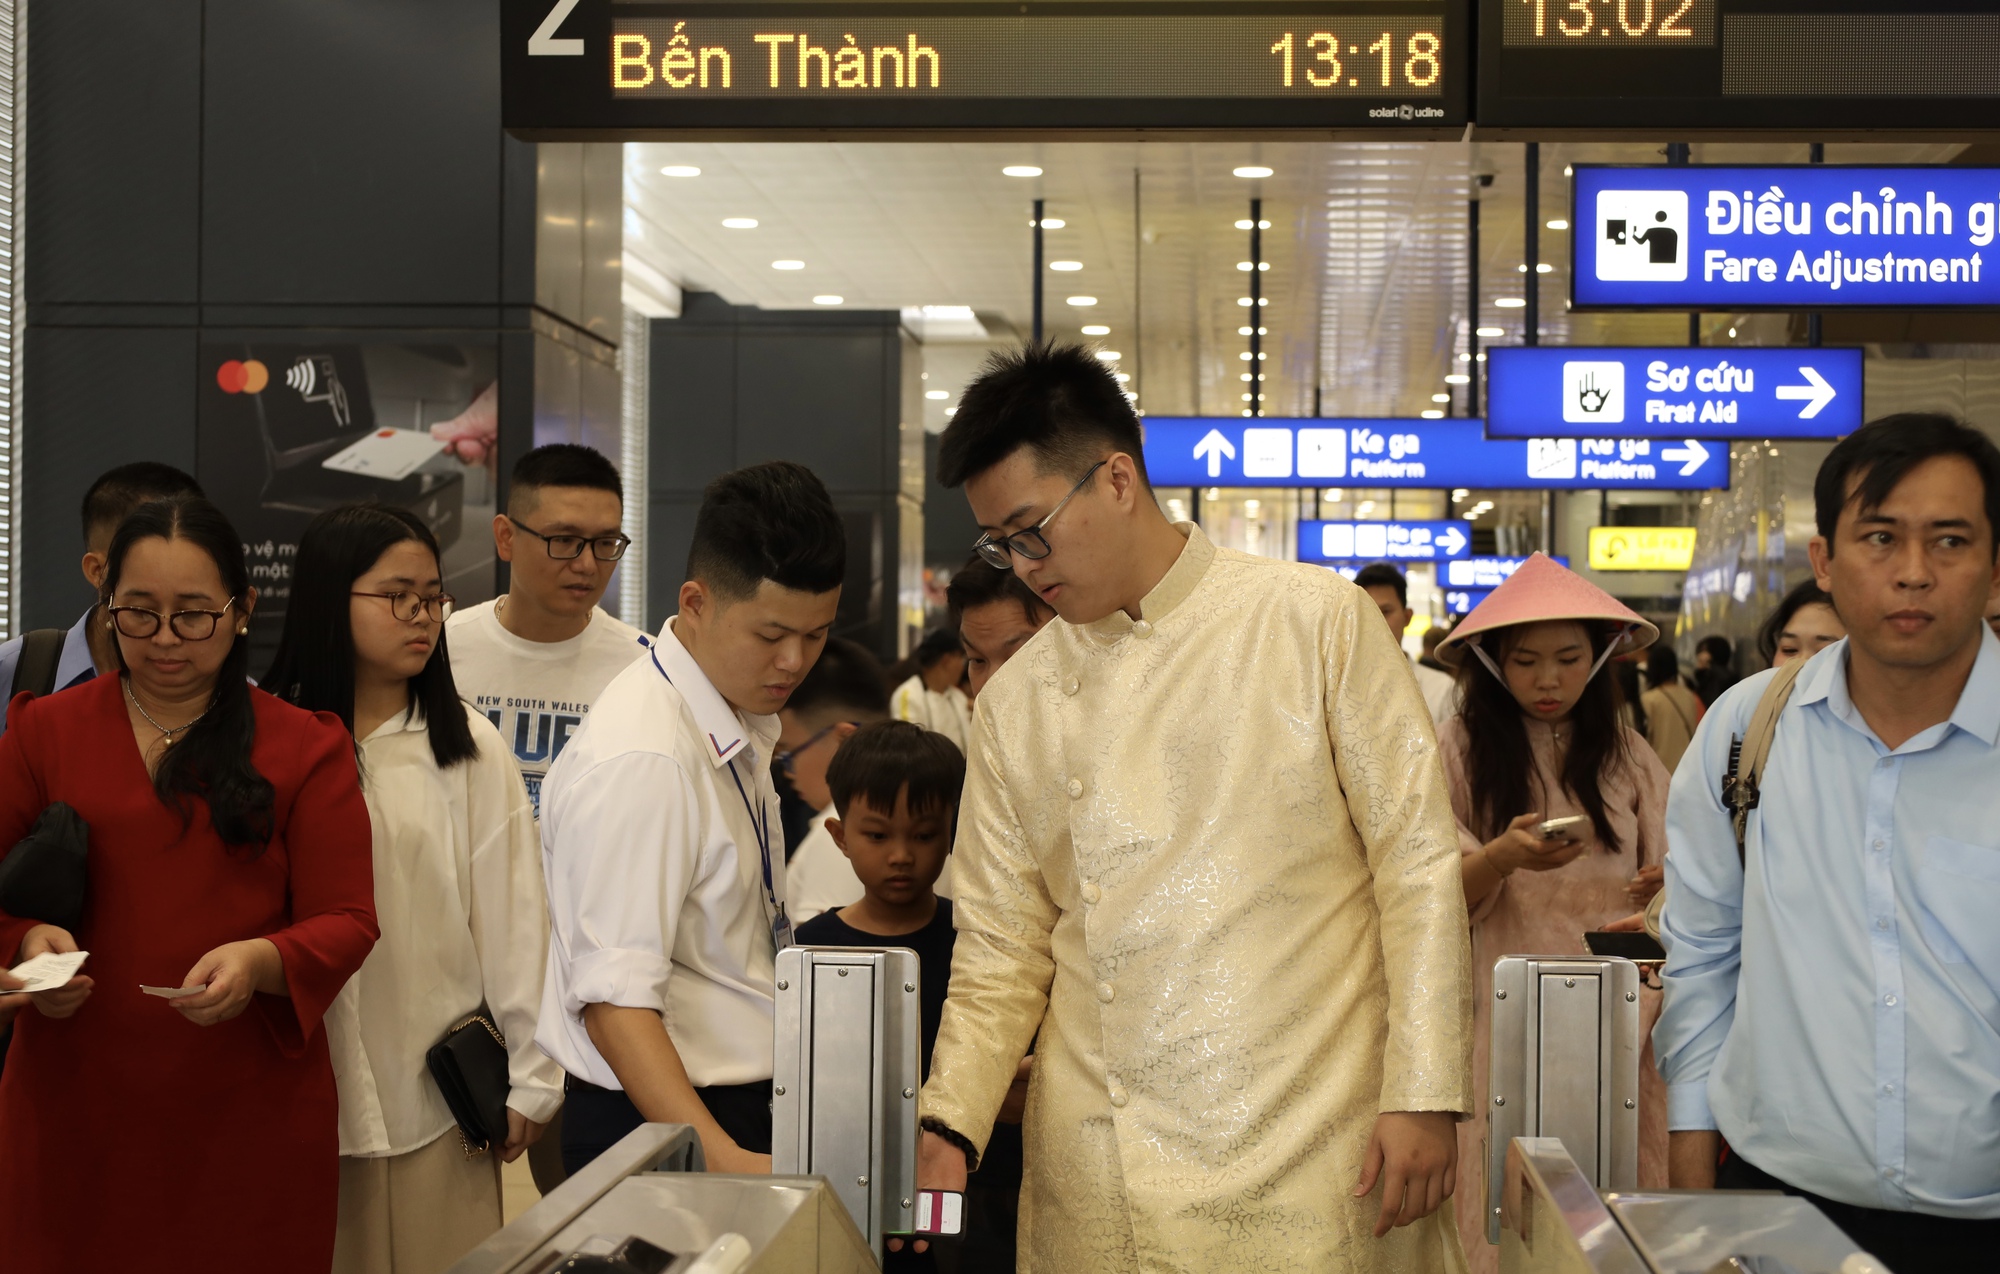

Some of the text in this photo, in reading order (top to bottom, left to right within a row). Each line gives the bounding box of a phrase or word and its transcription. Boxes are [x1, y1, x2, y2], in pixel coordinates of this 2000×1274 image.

[612, 21, 1440, 88] Bến Thành 13:18
[1369, 107, 1444, 118] solari udine
[1705, 185, 2000, 246] Điều chỉnh g
[1704, 249, 1983, 290] Fare Adjustment
[1645, 361, 1754, 392] Sơ cứu
[1645, 400, 1738, 423] First Aid
[1351, 428, 1421, 459] Ke ga
[1351, 458, 1426, 478] Platform
[1581, 459, 1656, 479] Platform
[477, 695, 589, 713] NEW SOUTH WALES
